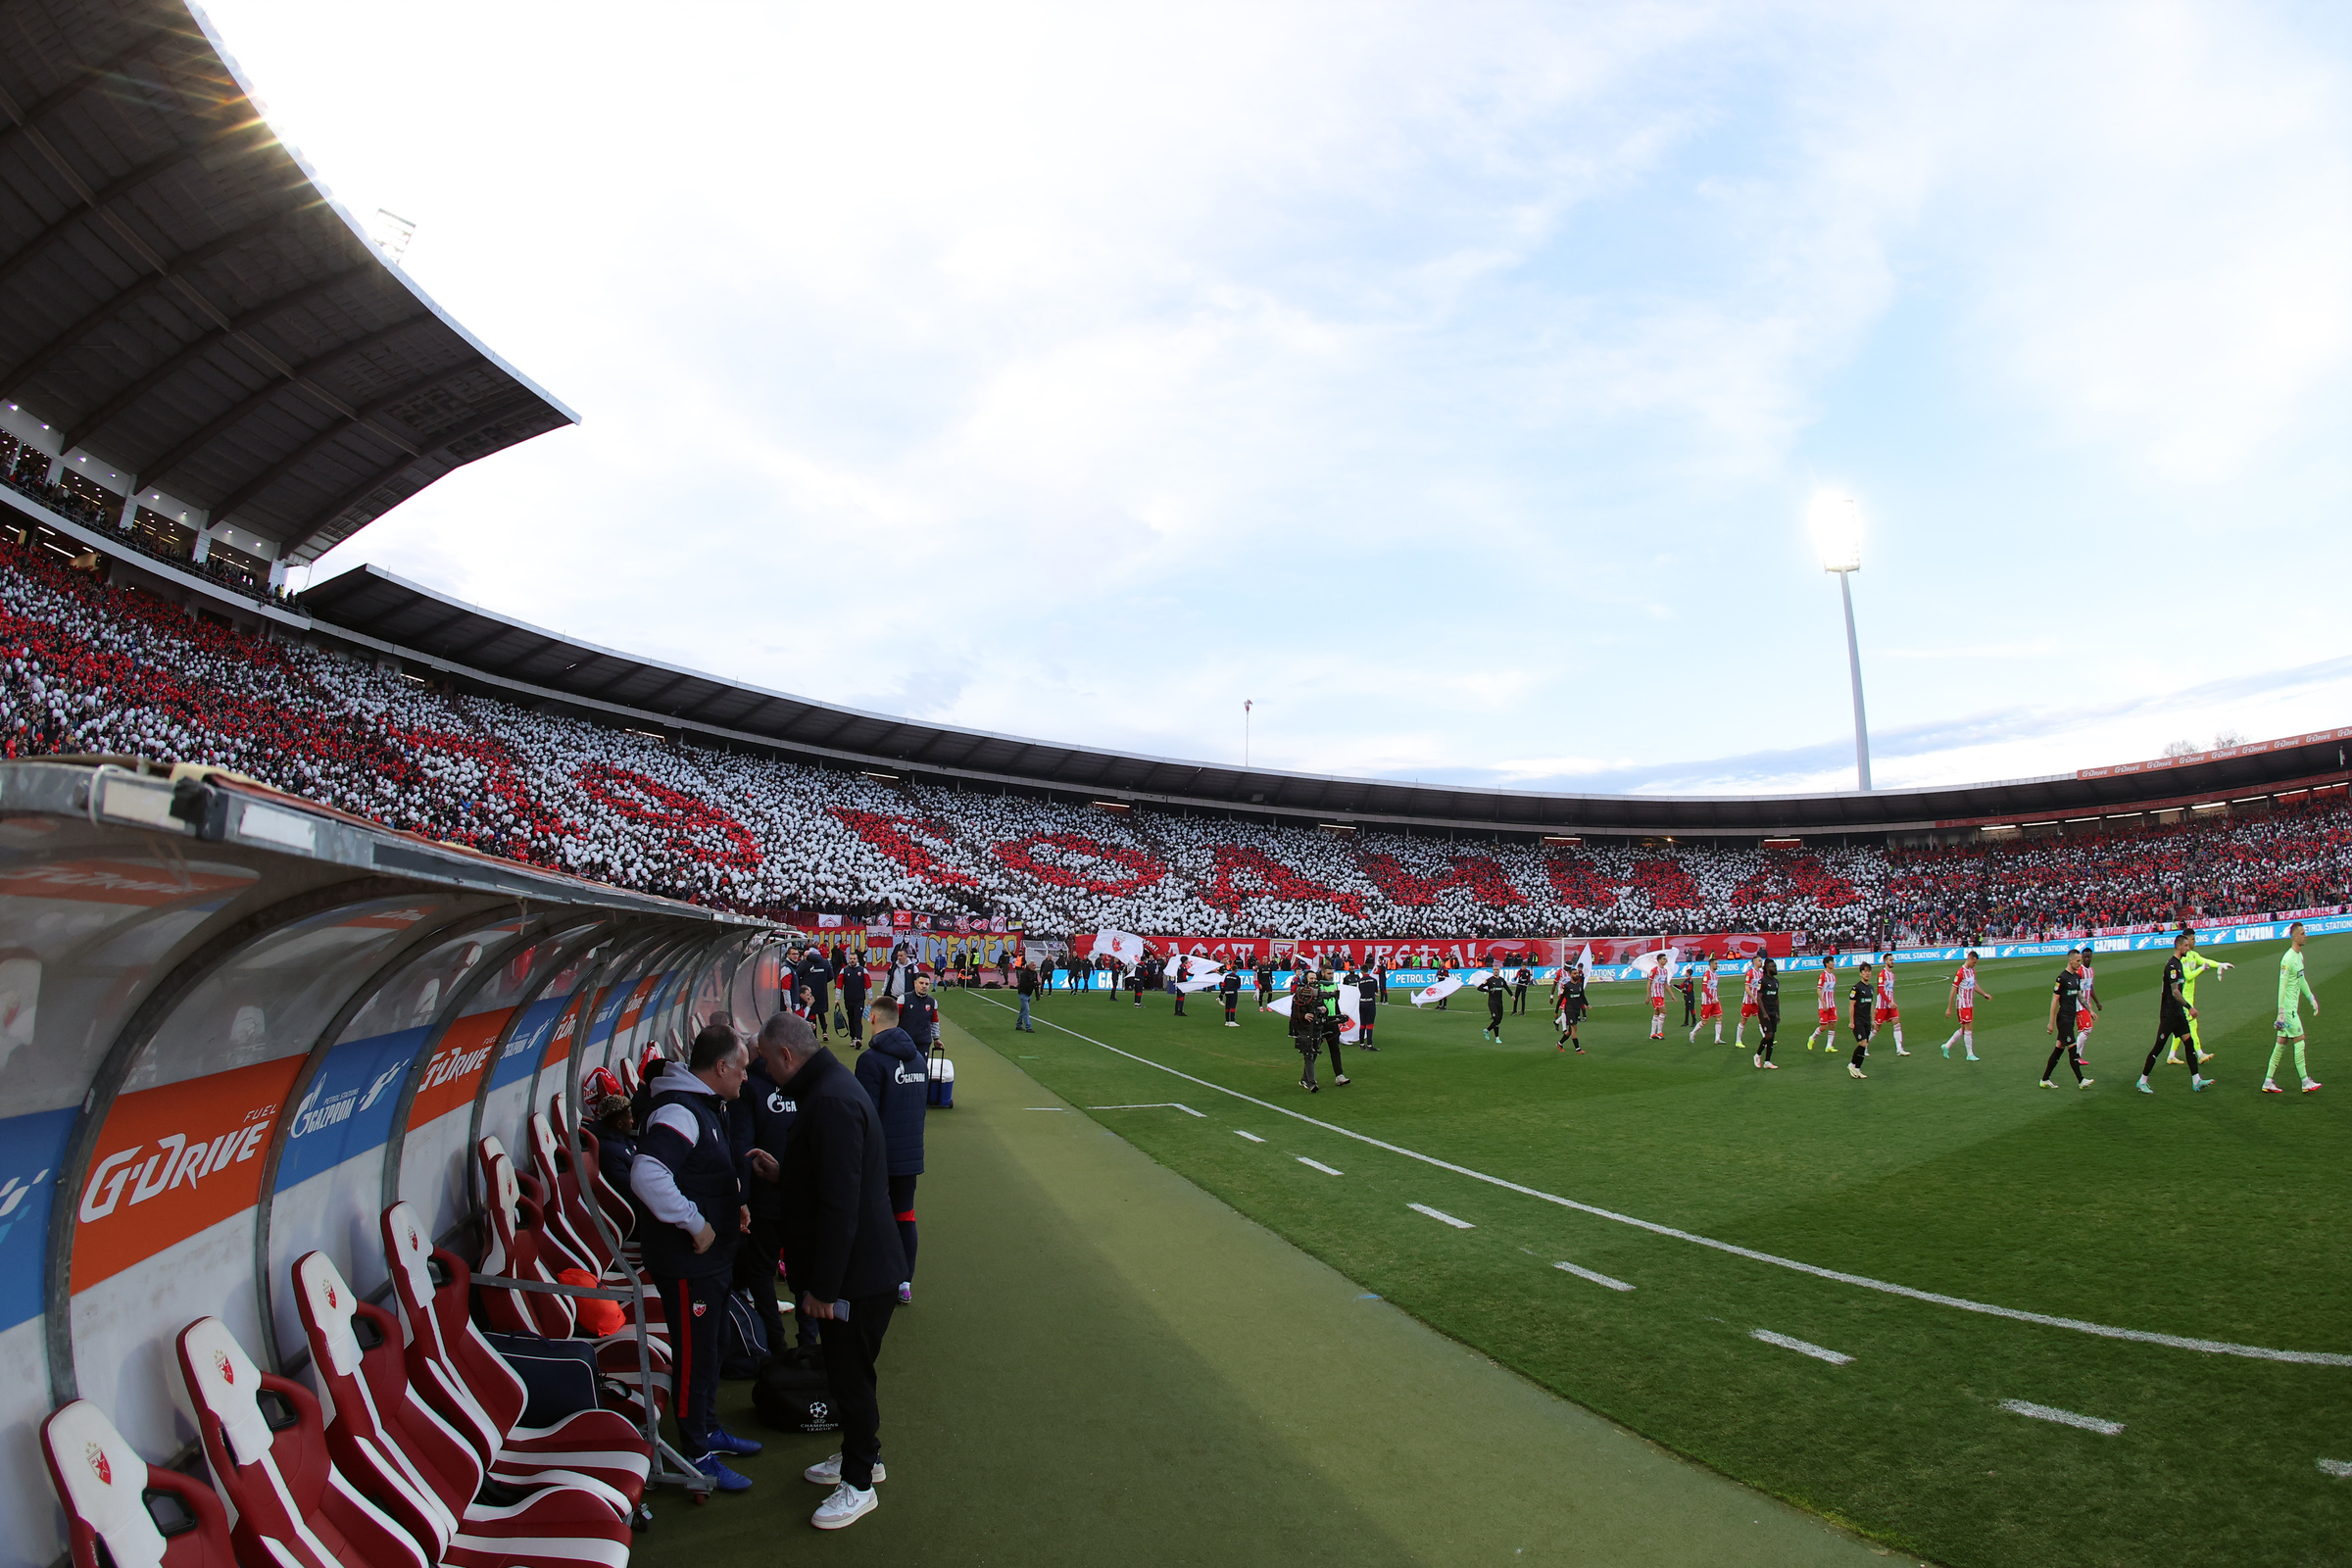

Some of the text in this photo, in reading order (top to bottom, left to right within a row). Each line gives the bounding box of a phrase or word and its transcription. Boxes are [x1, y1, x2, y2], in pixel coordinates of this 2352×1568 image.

[2304, 921, 2325, 933] ETROL
[2235, 926, 2275, 942] GAZPROM
[2041, 944, 2070, 954] STATIONS
[2093, 939, 2131, 953] GAZPROM
[1913, 951, 1940, 959] STATIONS
[1396, 973, 1426, 984] PETROL
[243, 1103, 277, 1123] FUEL
[307, 1097, 357, 1134] GAZPROM
